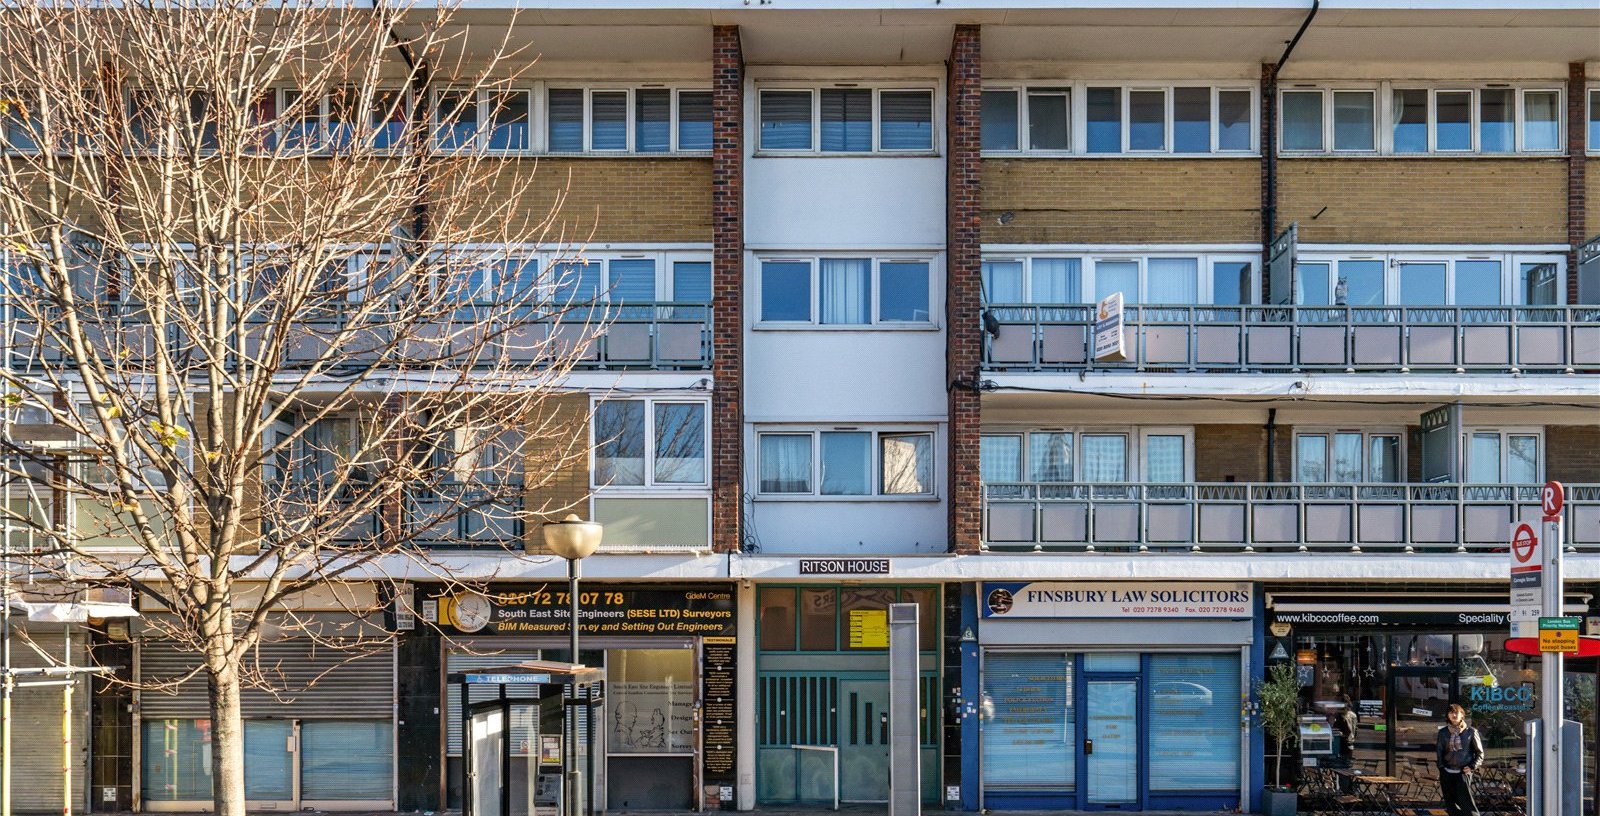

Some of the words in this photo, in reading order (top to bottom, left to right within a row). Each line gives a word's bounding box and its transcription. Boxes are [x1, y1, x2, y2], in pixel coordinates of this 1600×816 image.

[1544, 487, 1555, 512] R
[801, 561, 844, 573] RITSON
[847, 561, 888, 573] HOUSE
[499, 592, 527, 605] 020
[533, 592, 551, 605] 72
[580, 592, 599, 605] 07
[605, 592, 624, 605] 78
[708, 592, 731, 600] Centre
[1027, 590, 1108, 603] FINSBURY
[1112, 590, 1147, 603] LAW
[1150, 590, 1249, 603] SOLICITORS
[498, 609, 527, 618] South
[529, 609, 551, 618] East
[553, 609, 571, 618] Site
[577, 609, 625, 619] Engineers
[627, 609, 656, 619] (SESE
[658, 609, 680, 619] LTD)
[682, 609, 731, 619] Surveyors
[1276, 613, 1379, 623] www.kibcocoffee.com
[1458, 613, 1504, 625] Speciality
[498, 622, 517, 631] BIM
[519, 622, 565, 631] Measured
[601, 622, 619, 631] and
[621, 622, 655, 632] Setting
[657, 622, 675, 631] Out
[676, 622, 723, 632] Engineers
[486, 675, 539, 683] TELEPHONE
[1471, 686, 1532, 701] KIBCO
[1472, 703, 1497, 711] Coffee
[1498, 703, 1530, 711] Roasters
